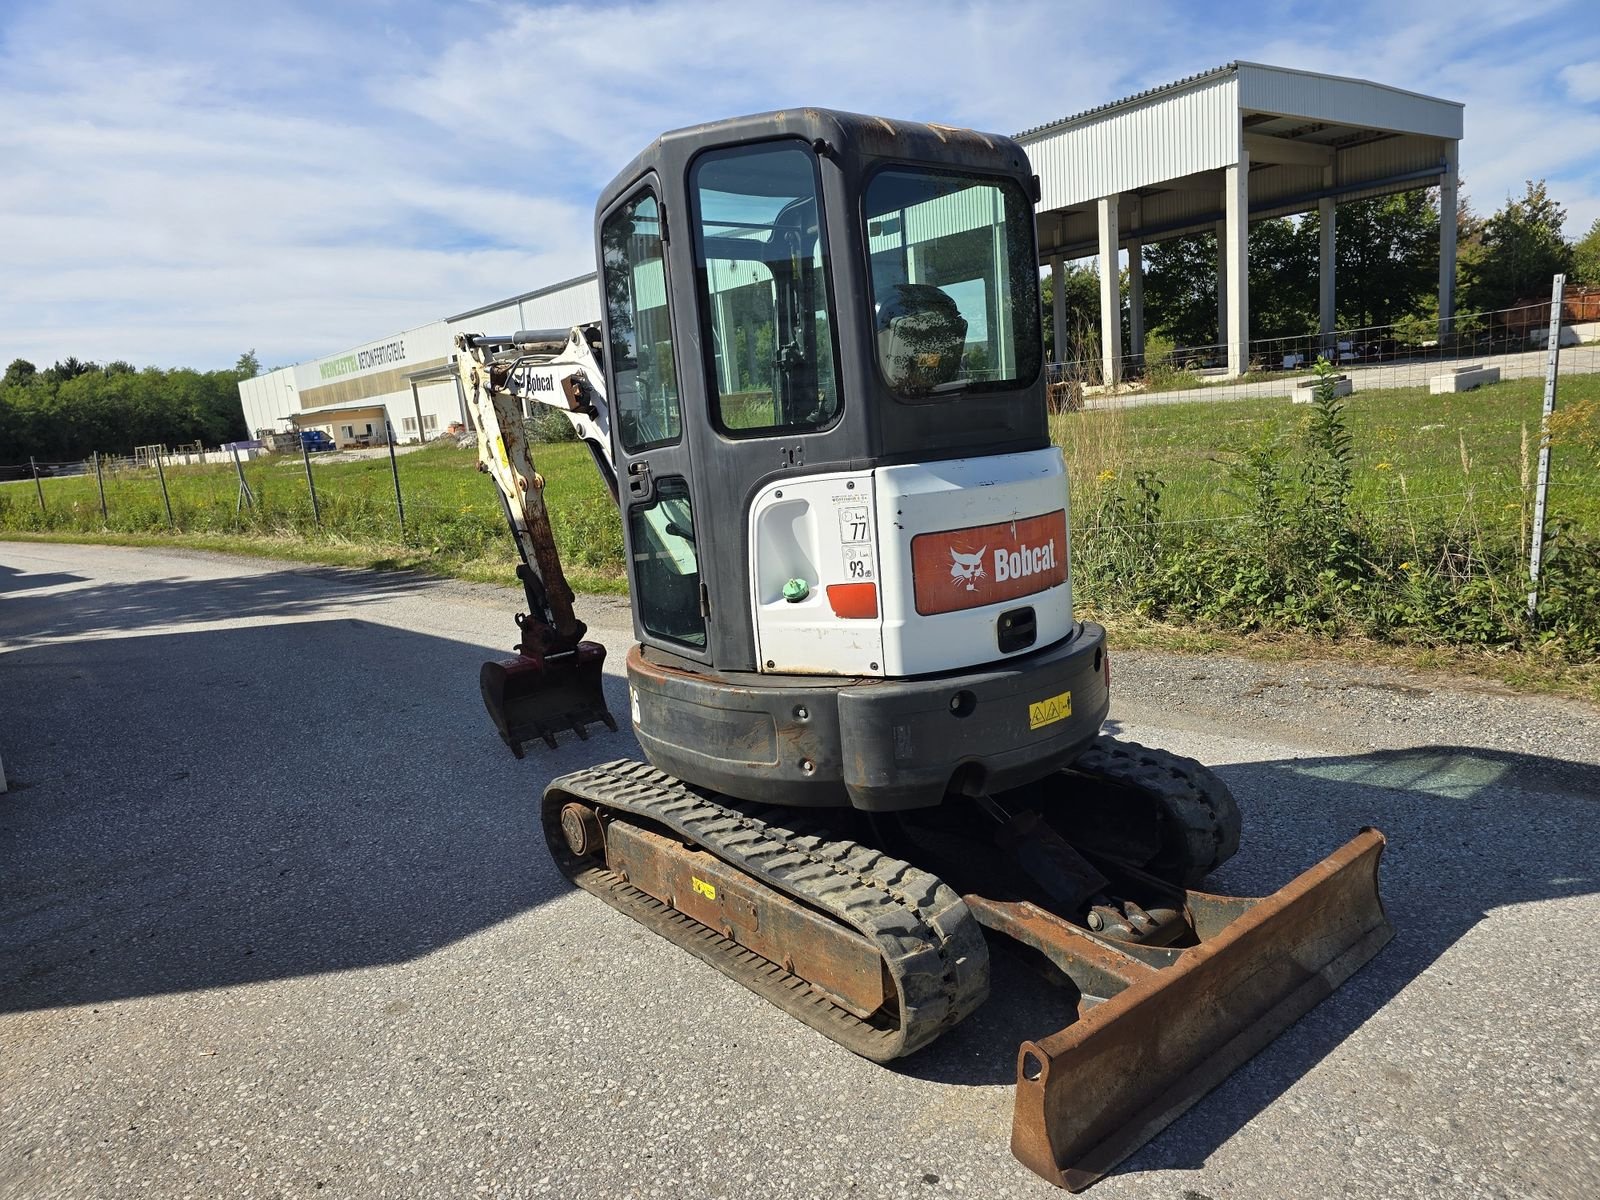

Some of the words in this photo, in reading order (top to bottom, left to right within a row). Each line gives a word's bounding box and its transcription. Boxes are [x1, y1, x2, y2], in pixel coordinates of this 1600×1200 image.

[358, 340, 406, 370] BETONFERTIGTEILE
[526, 373, 554, 392] Bobcat
[850, 522, 866, 540] 77
[994, 538, 1056, 582] Bobcat
